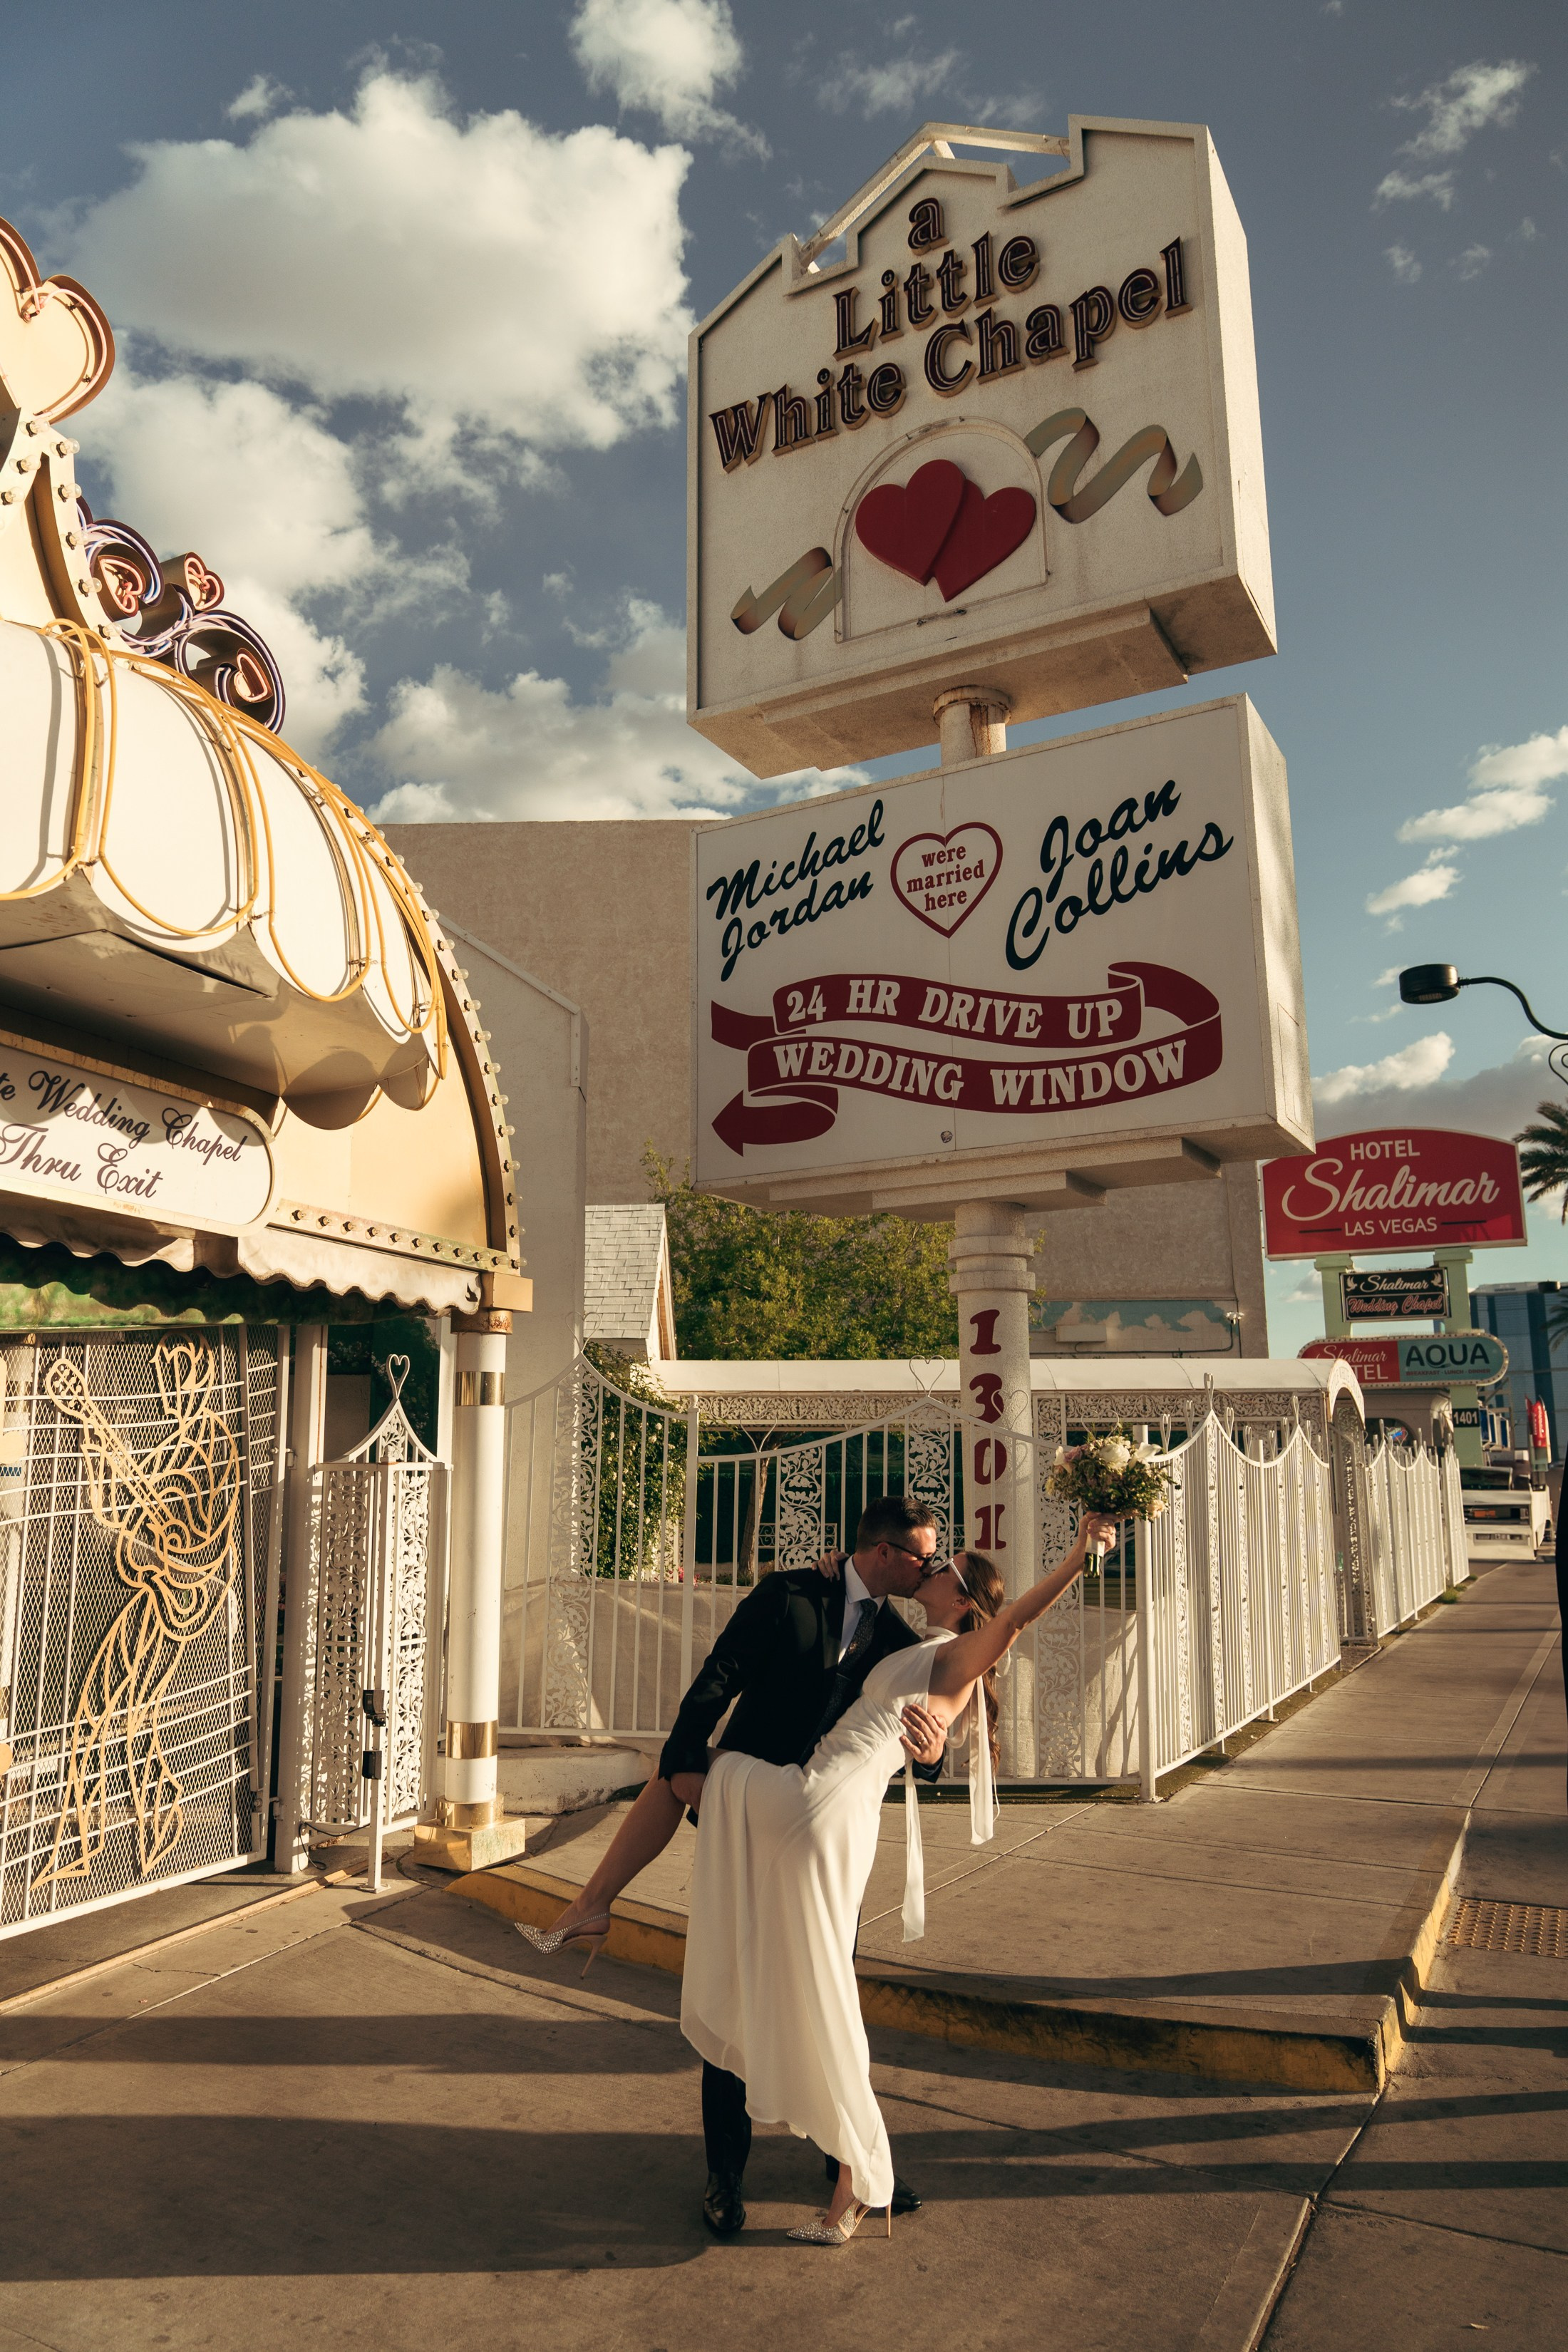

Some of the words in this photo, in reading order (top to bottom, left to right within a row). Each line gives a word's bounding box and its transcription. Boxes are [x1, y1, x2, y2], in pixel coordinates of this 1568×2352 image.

[908, 197, 948, 255] a
[832, 230, 1040, 360] Little
[708, 361, 906, 473] White
[924, 236, 1192, 398] Chapel
[706, 799, 885, 919] Michael
[921, 845, 967, 868] were
[1039, 780, 1182, 903] Joan
[907, 861, 985, 894] married
[924, 889, 968, 912] here
[1005, 822, 1234, 971] Collins
[720, 871, 874, 982] Jordan
[786, 984, 827, 1022] 24
[846, 979, 902, 1017] HR
[918, 989, 1043, 1040] DRIVE
[1068, 999, 1123, 1040] UP
[773, 1042, 964, 1102] WEDDING
[990, 1040, 1187, 1106] WINDOW
[29, 1070, 150, 1149] Wedding
[162, 1108, 248, 1165] Chapel
[0, 1123, 82, 1181] Thru
[96, 1143, 163, 1198] Exit
[1351, 1138, 1420, 1161] HOTEL
[1281, 1157, 1500, 1222] Shalimar
[1344, 1220, 1375, 1237] LAS
[1378, 1217, 1437, 1234] VEGAS
[1348, 1297, 1398, 1316] Wedding
[1401, 1294, 1443, 1314] Chapel
[1360, 1275, 1429, 1292] Shalimar
[1351, 1363, 1388, 1381] TEL
[1405, 1342, 1490, 1368] AQUA
[1453, 1410, 1479, 1425] 1401
